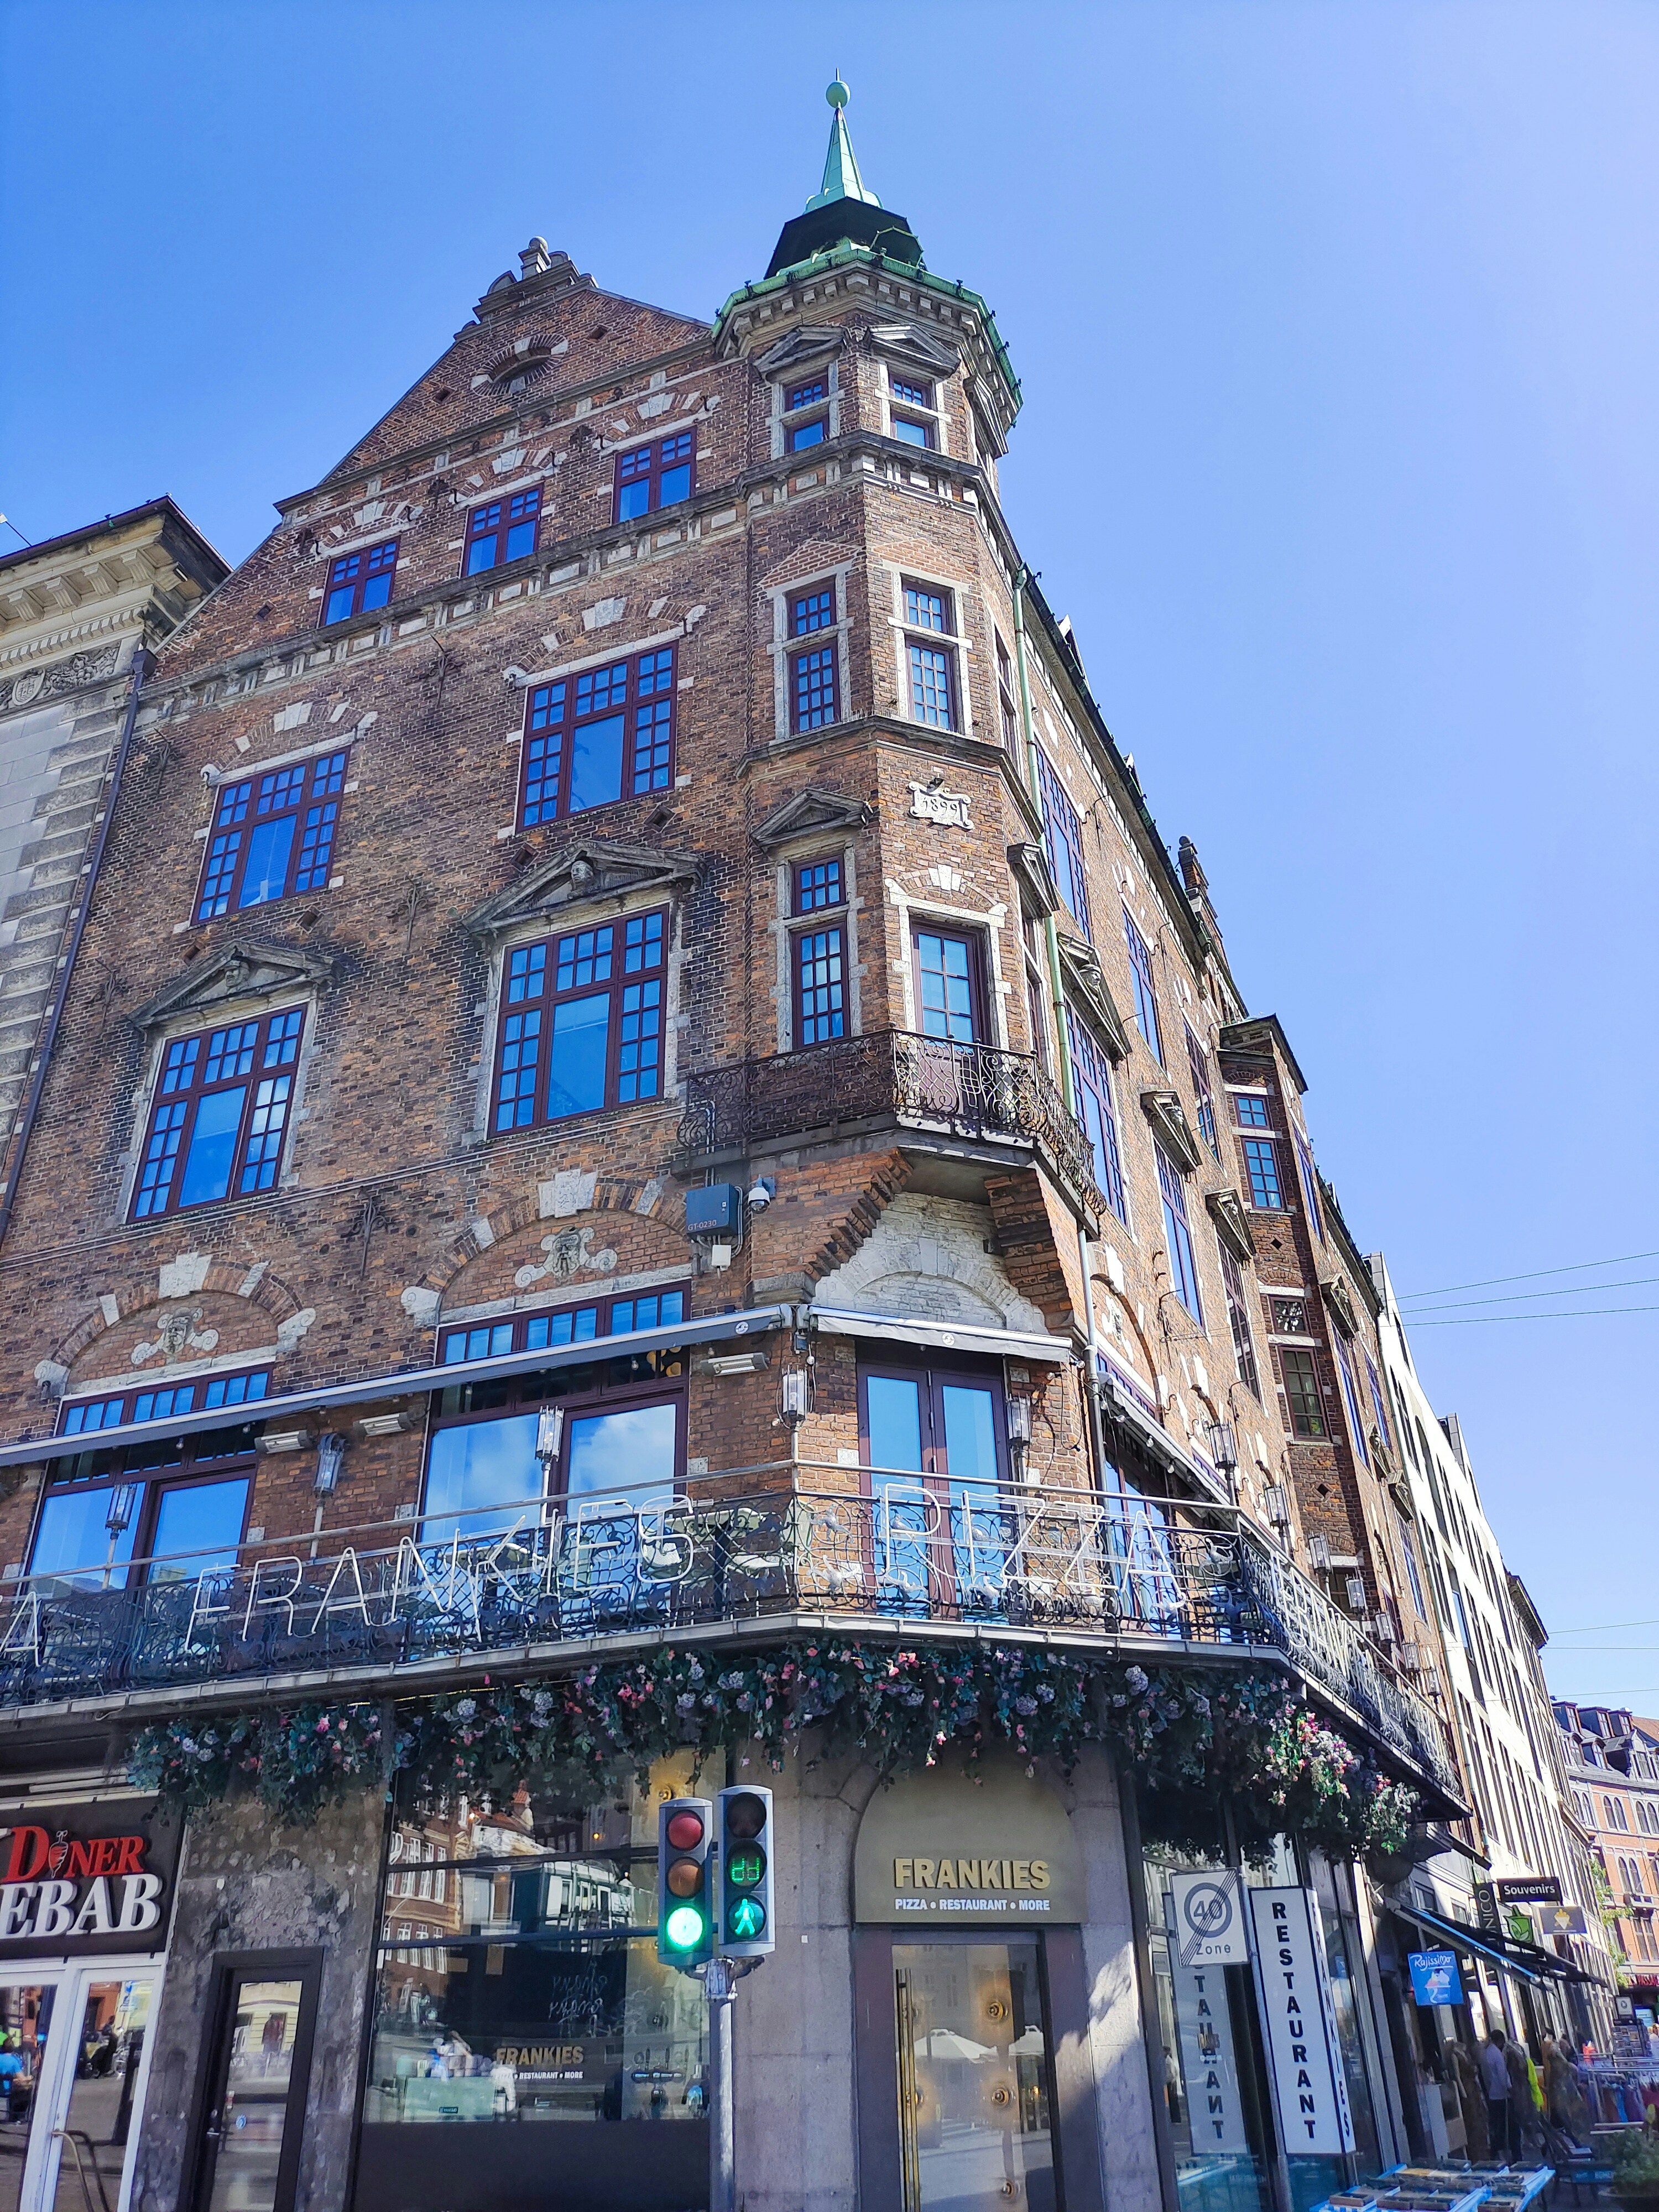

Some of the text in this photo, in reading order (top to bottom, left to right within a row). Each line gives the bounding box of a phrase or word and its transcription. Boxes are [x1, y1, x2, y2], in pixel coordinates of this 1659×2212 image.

[922, 797, 957, 815] 1899
[687, 1219, 717, 1231] GT-0230
[885, 1483, 1182, 1599] PIZZA
[185, 1495, 693, 1652] FRANKIES
[894, 1858, 1050, 1889] FRANKIES
[1504, 1884, 1556, 1895] Souvenirs
[0, 1873, 161, 1939] EBAB
[895, 1898, 1050, 1911] PIZZA RESTAURANT MORE
[1193, 1900, 1222, 1919] 40
[1196, 1943, 1231, 1955] Zone
[1272, 1902, 1316, 2139] RESTAURANT
[1311, 1903, 1350, 2137] FRANKIES
[496, 2046, 584, 2065] FRANKIES
